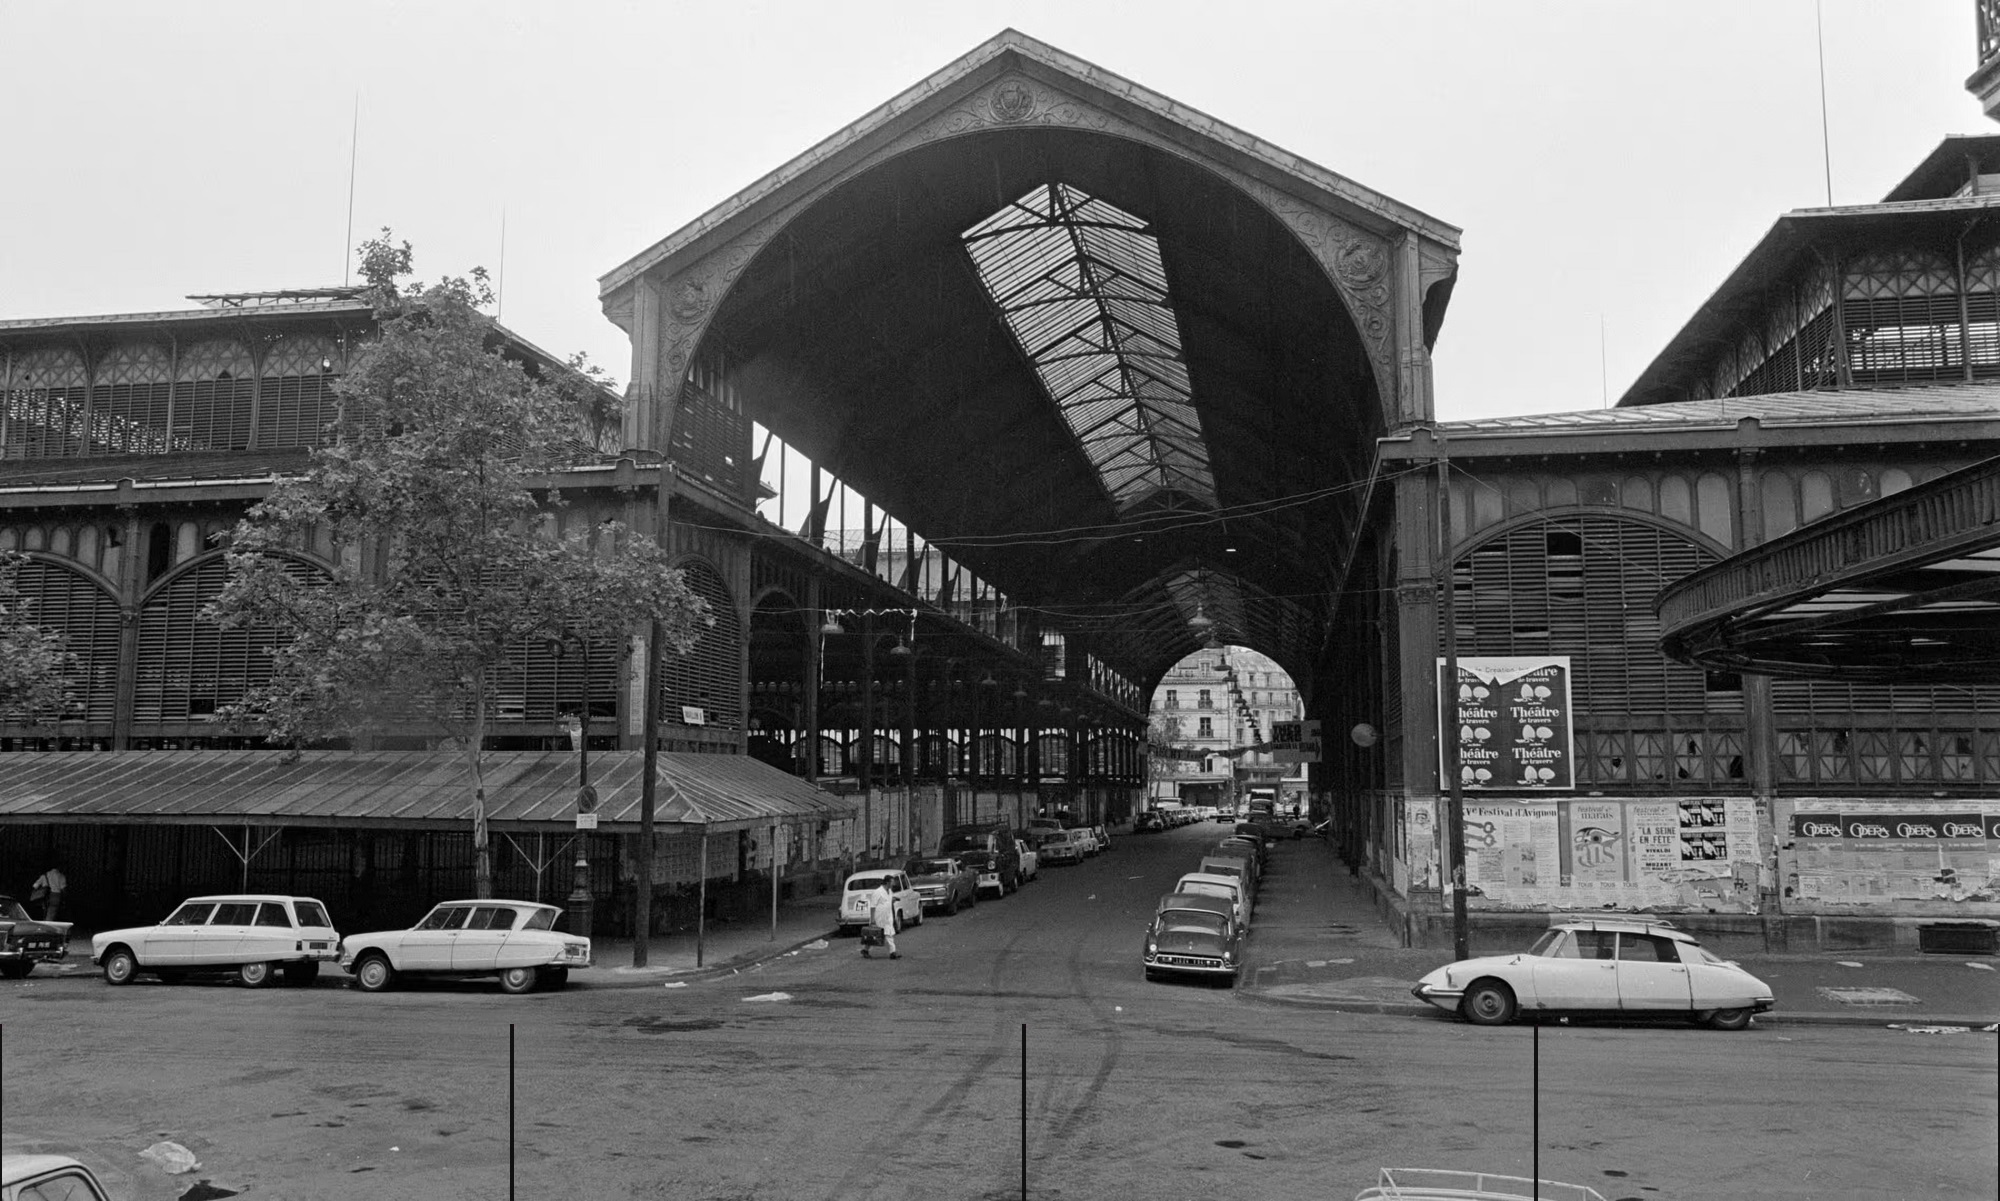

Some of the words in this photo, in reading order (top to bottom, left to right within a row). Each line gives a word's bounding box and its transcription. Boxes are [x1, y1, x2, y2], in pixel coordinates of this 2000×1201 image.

[1458, 707, 1498, 718] héâtre
[1510, 706, 1560, 718] Théâtre
[1460, 747, 1499, 759] héâtre
[1511, 747, 1562, 759] Théâtre
[1479, 807, 1513, 817] Festival
[1515, 808, 1557, 819] d'Avignon
[1655, 826, 1676, 835] SEINE
[1639, 835, 1649, 844] EN
